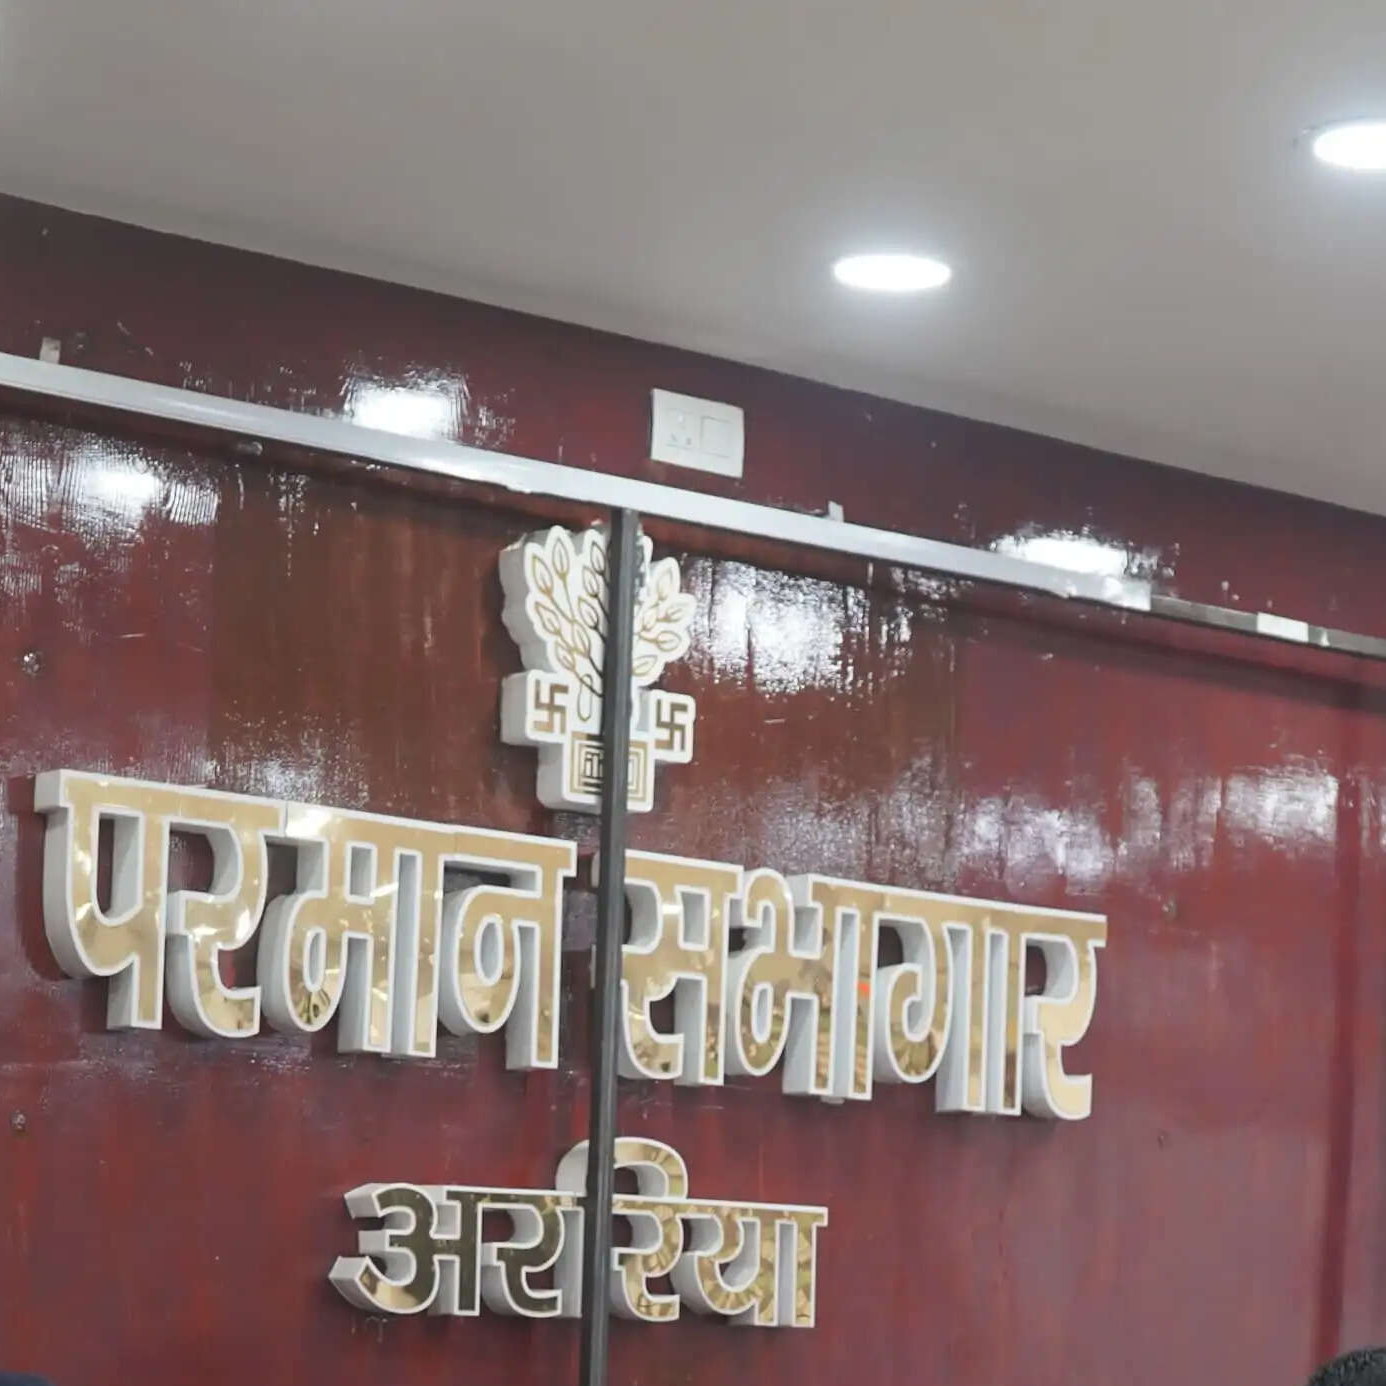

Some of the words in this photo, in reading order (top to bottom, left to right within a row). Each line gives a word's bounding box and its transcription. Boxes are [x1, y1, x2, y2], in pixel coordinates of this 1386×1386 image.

[36, 769, 577, 1070] परमान
[593, 849, 1107, 1120] सभागार
[329, 1137, 828, 1328] अररिया
